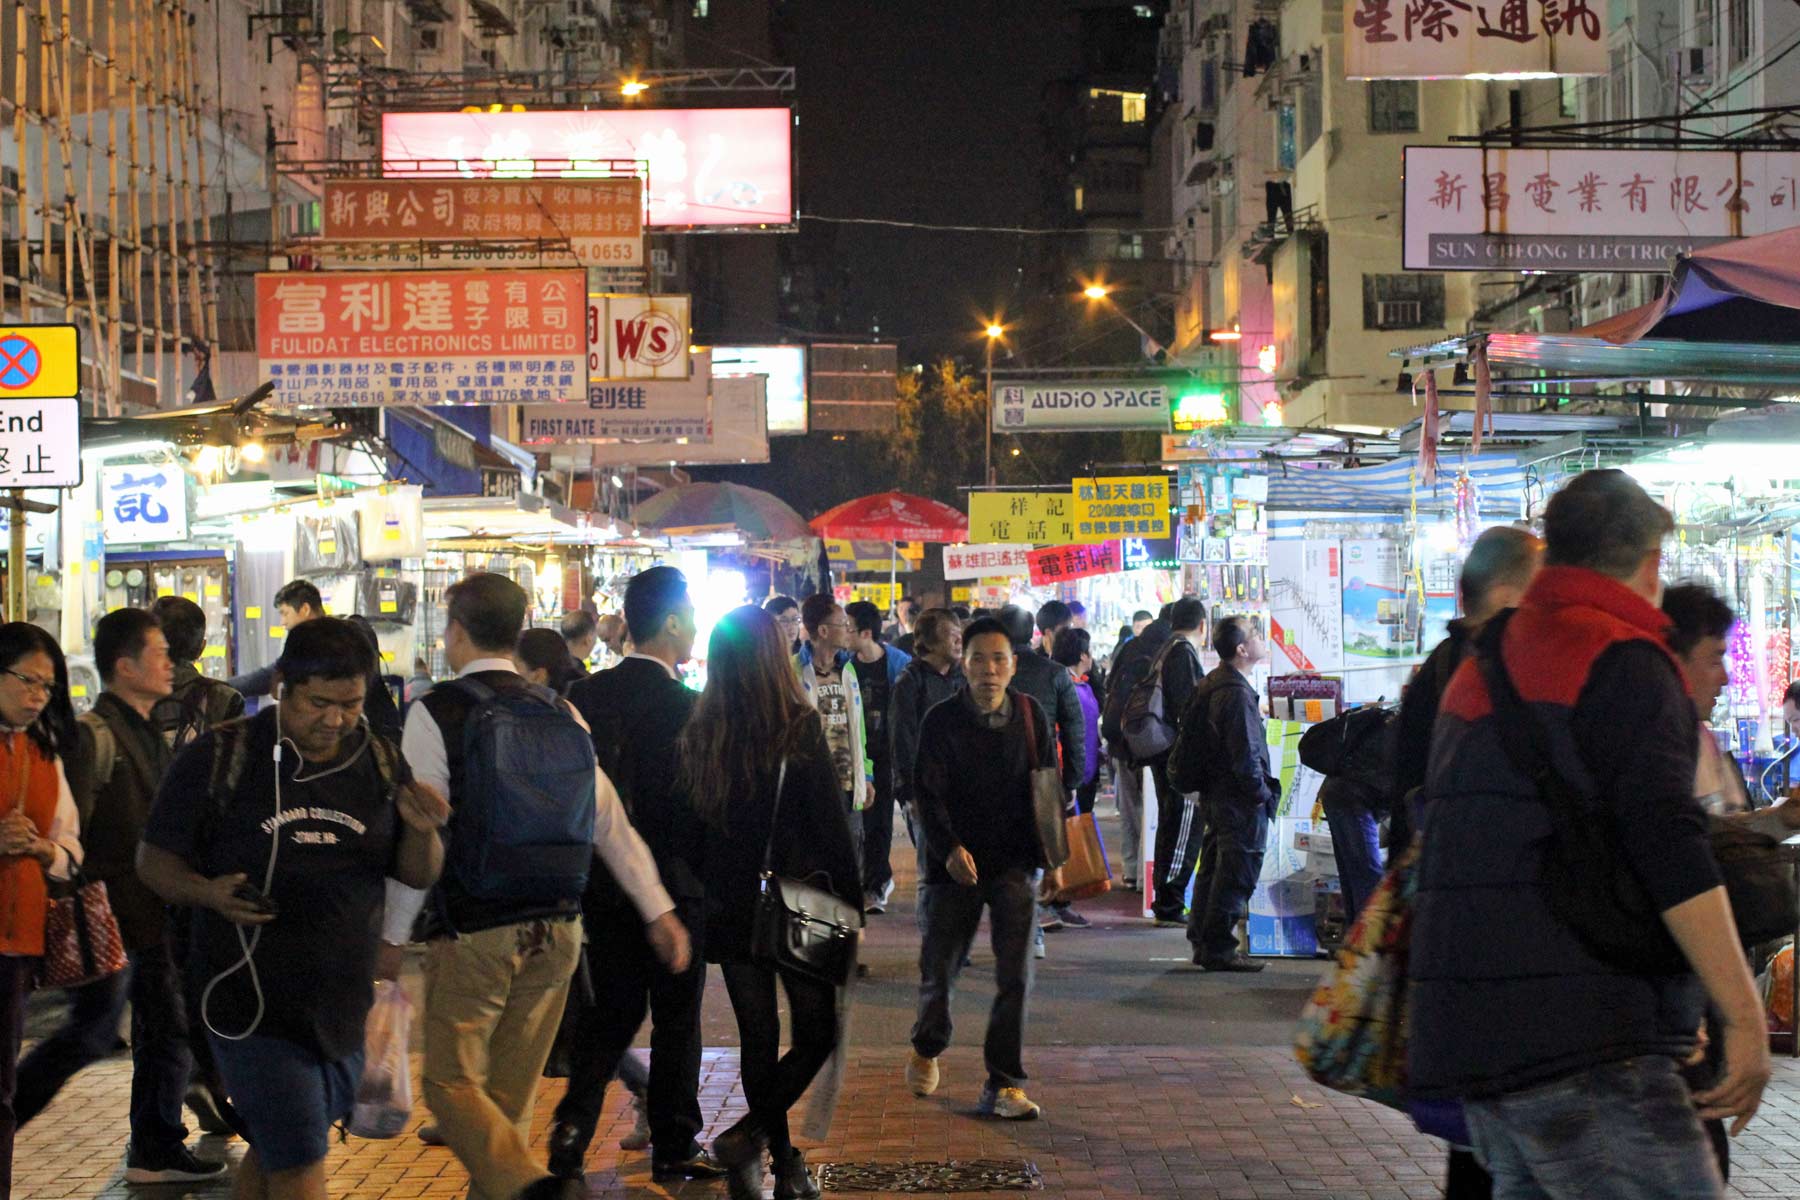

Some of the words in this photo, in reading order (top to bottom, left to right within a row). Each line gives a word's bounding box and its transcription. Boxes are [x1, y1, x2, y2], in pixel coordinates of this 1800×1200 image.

[1353, 0, 1601, 44] 星際通訊
[1428, 170, 1798, 214] 新昌電業有限公司
[331, 188, 455, 228] 新興公司
[591, 244, 633, 260] 0653
[1435, 241, 1476, 259] SUN
[276, 281, 455, 333] 富利達
[271, 335, 353, 355] FULIDAT
[360, 334, 492, 353] ELECTRONICS
[501, 333, 576, 351] LIMITED
[1102, 389, 1161, 408] SPACE
[0, 410, 43, 432] nd
[530, 419, 562, 436] FIRST
[566, 418, 596, 436] RATE
[110, 472, 169, 523] 記
[1009, 497, 1064, 517] 祥記
